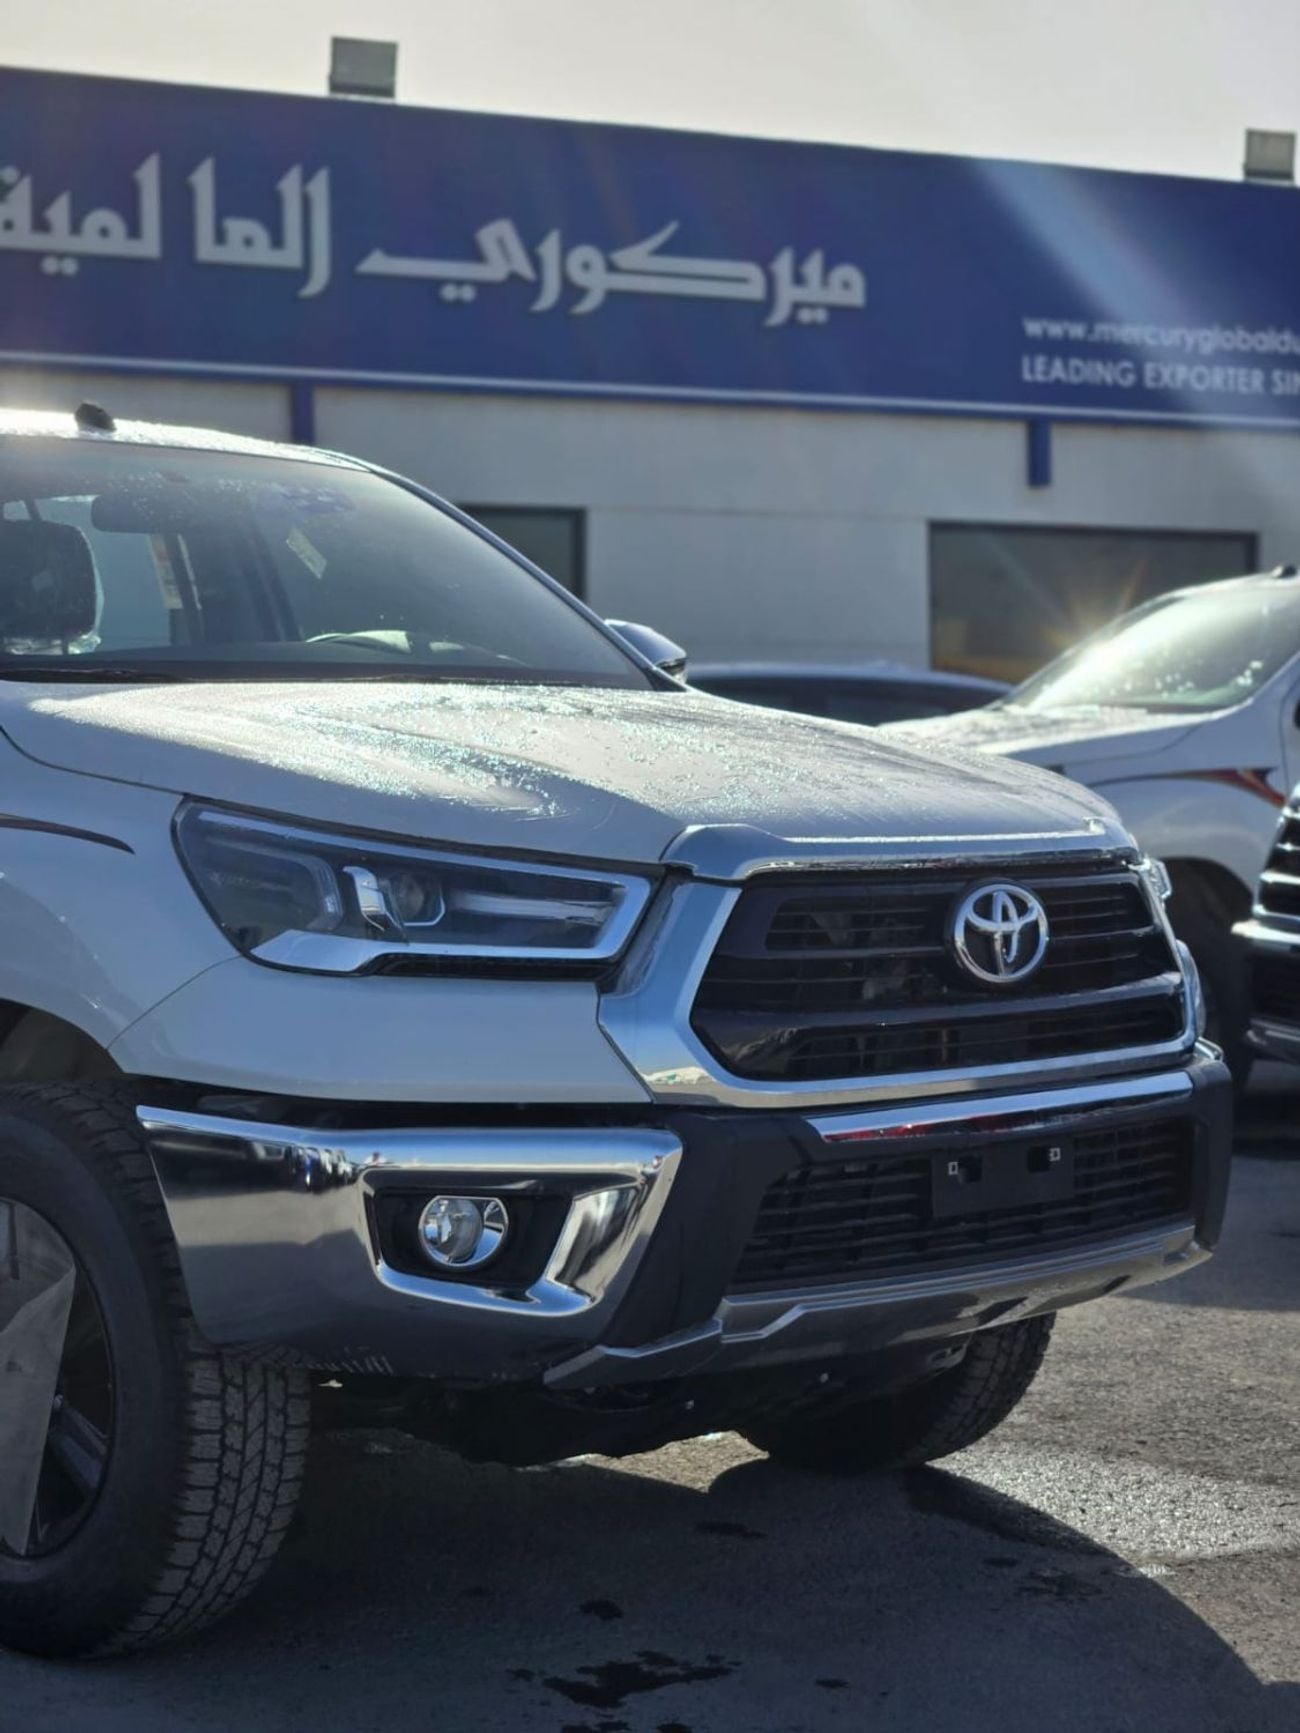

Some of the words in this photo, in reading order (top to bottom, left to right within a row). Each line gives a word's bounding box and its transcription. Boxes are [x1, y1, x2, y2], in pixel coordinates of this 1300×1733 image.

[355, 219, 866, 326] ميركوري
[1021, 354, 1137, 389] LEADING
[1143, 362, 1265, 395] EXPORTER
